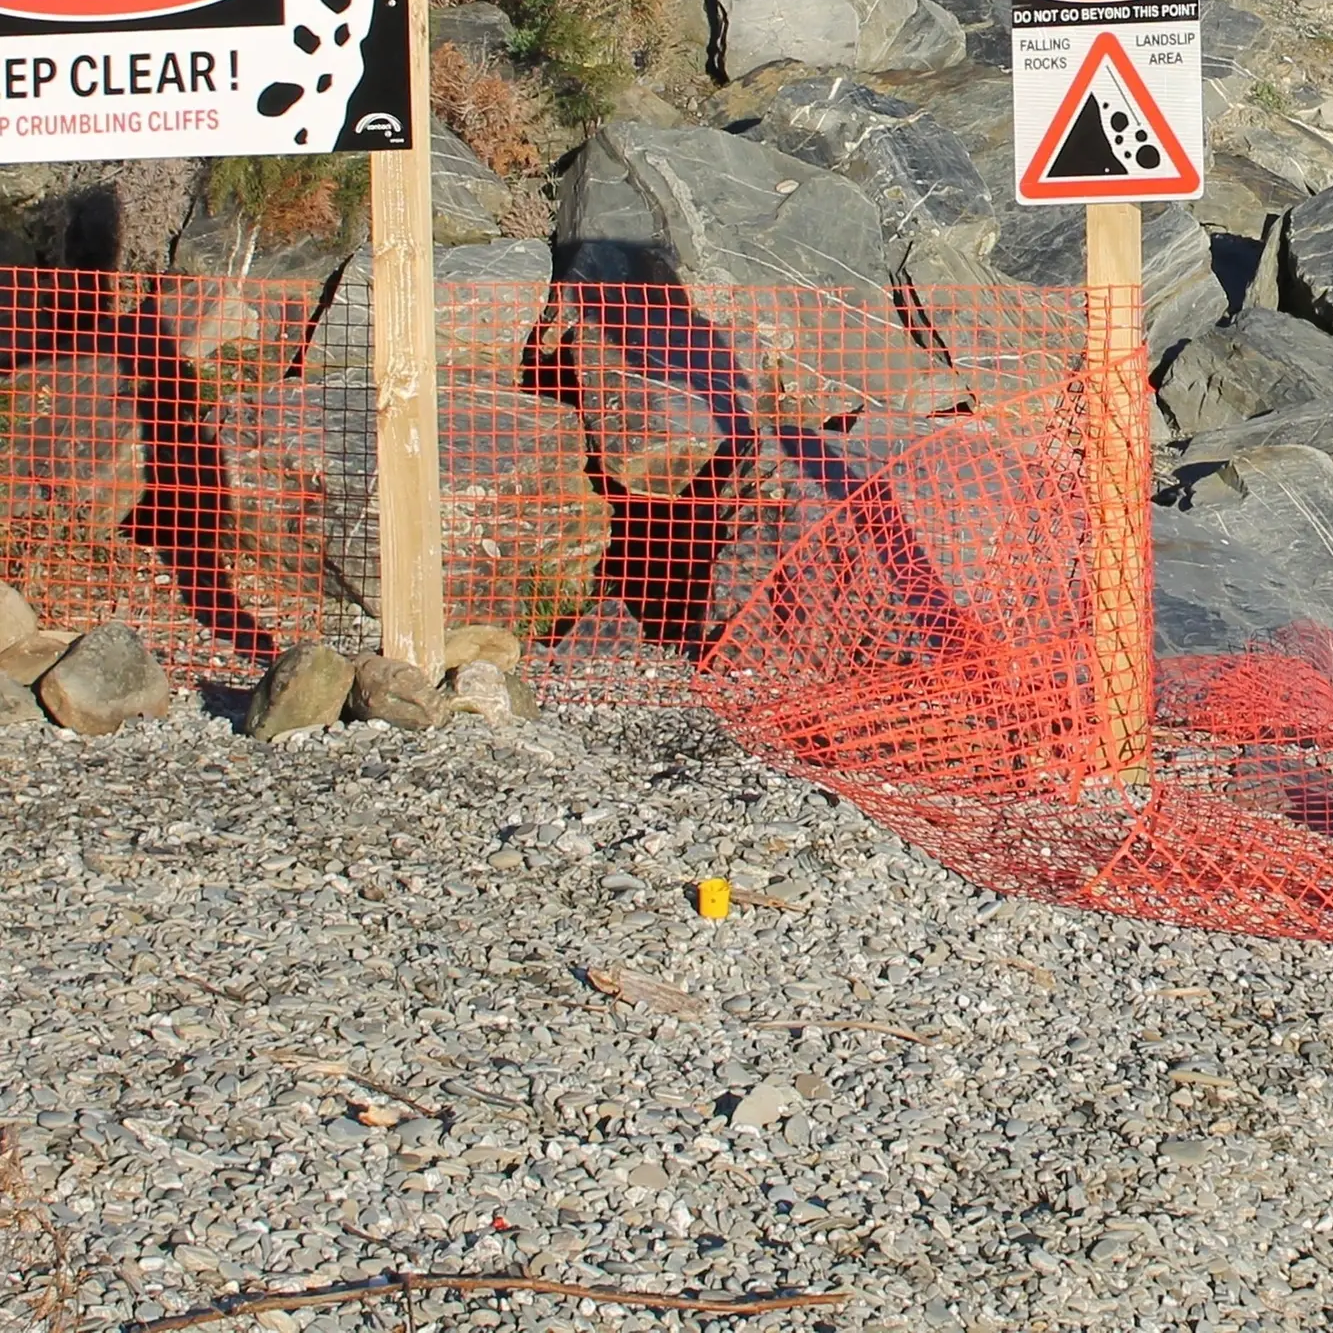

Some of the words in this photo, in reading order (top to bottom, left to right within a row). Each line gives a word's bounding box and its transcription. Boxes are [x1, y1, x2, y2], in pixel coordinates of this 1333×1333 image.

[1014, 10, 1032, 24] DO
[1034, 9, 1058, 23] NOT
[1060, 8, 1080, 22] GO
[1081, 6, 1130, 21] BEYOND
[1132, 4, 1159, 19] THIS
[1161, 3, 1197, 18] POINT
[1020, 38, 1071, 52] FALLING
[1136, 33, 1195, 47] LANDSLIP
[1024, 57, 1067, 70] ROCKS
[1149, 52, 1183, 65] AREA
[16, 110, 142, 136] CRUMBLING
[148, 109, 219, 132] CLIFFS
